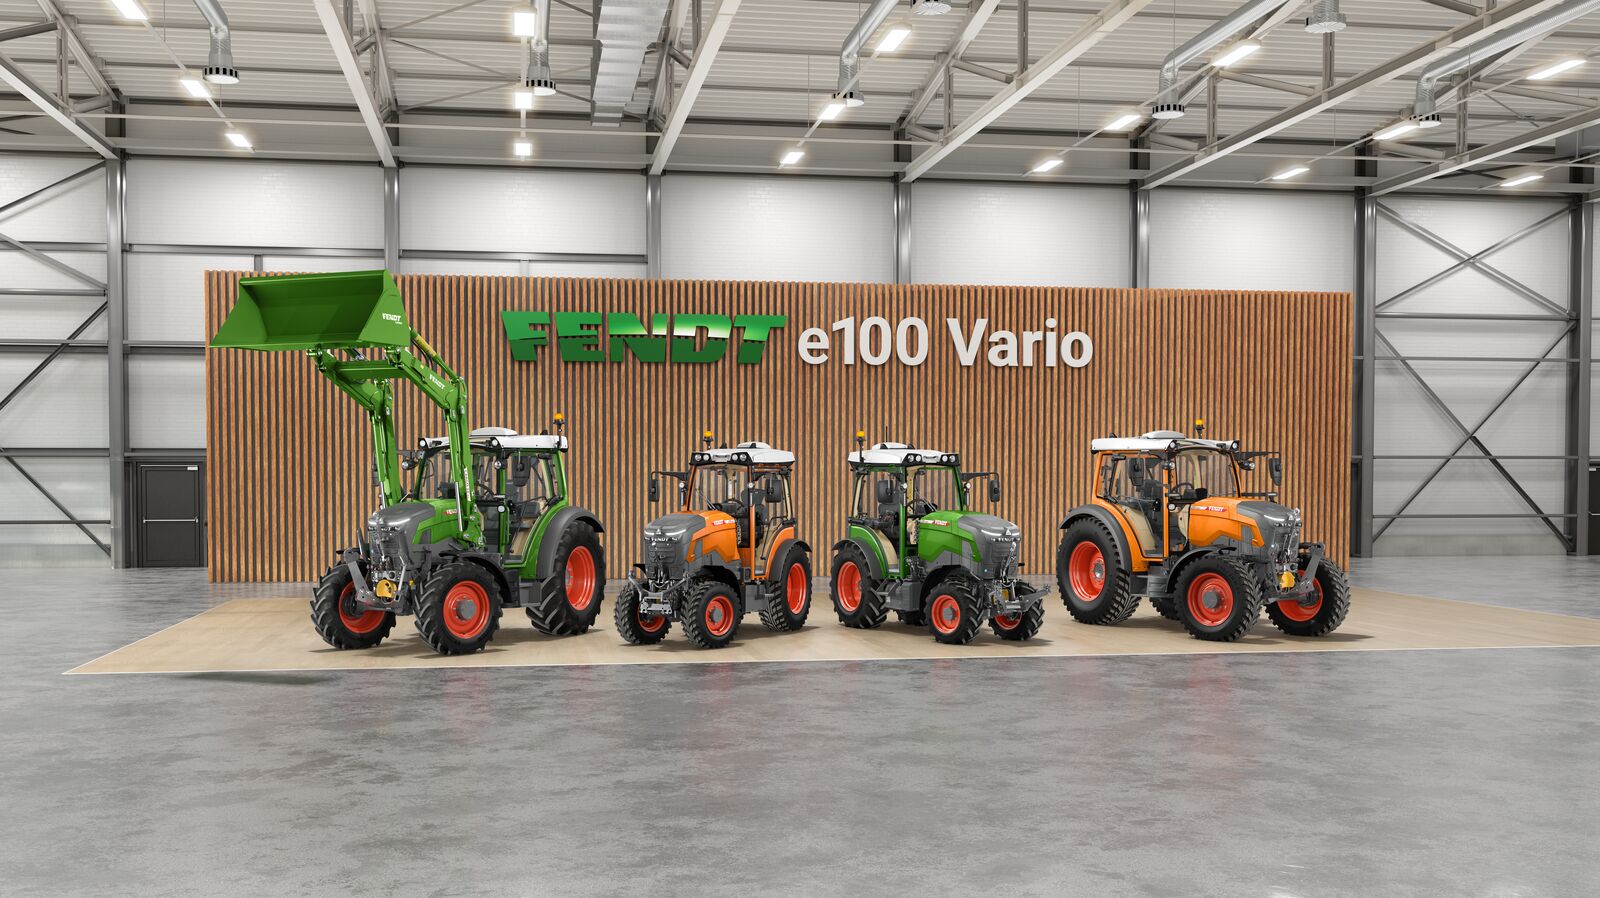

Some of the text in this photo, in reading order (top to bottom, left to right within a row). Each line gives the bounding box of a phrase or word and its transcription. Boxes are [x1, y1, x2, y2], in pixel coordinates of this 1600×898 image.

[382, 313, 401, 321] FENDT
[502, 311, 1094, 368] FENDT e100 Vario
[429, 374, 445, 389] FENDT
